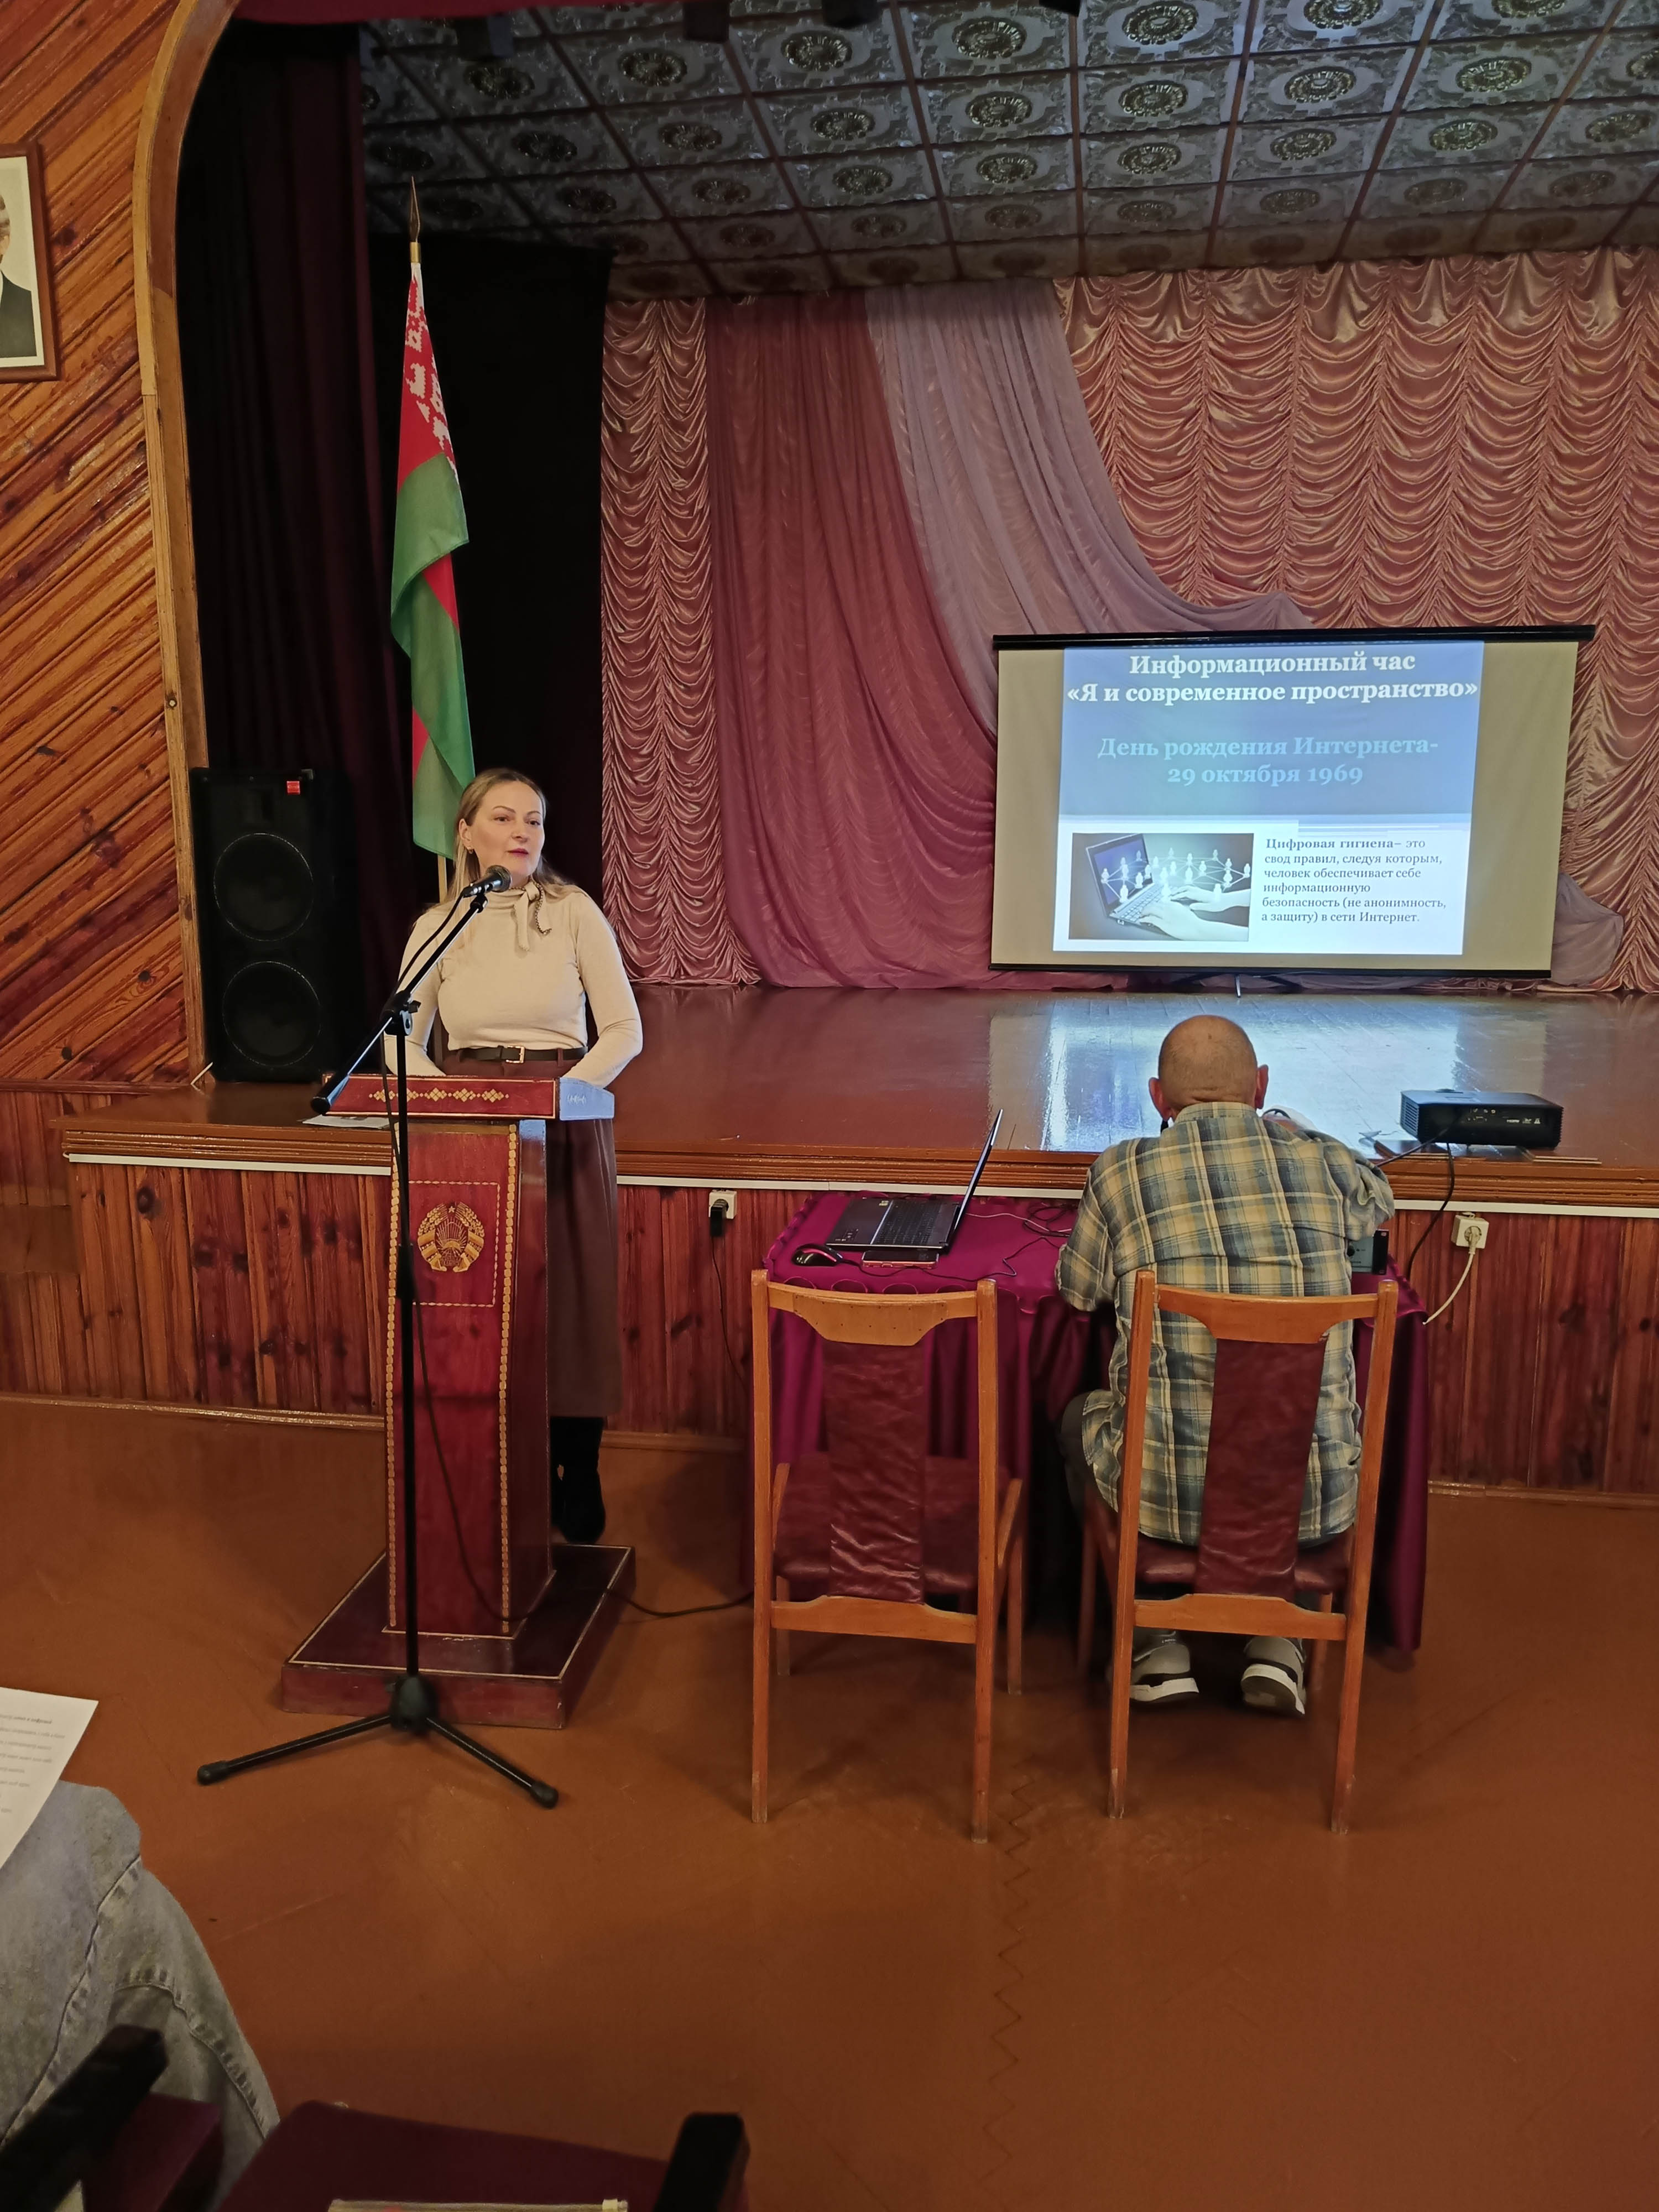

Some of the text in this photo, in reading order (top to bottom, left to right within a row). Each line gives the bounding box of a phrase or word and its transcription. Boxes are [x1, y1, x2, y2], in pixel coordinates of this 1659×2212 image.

[1129, 650, 1416, 678] Информационный час
[1067, 682, 1478, 706] «Я и современное пространство»
[1098, 738, 1159, 759] День
[1164, 739, 1287, 760] рождения
[1167, 764, 1364, 787] 29 октября 1969
[1266, 839, 1335, 850] Цифровая
[1265, 854, 1442, 865] свод правил, следуя которым,
[1264, 868, 1421, 878] человек обеспечивает себе
[1264, 883, 1370, 894] информационную
[1262, 897, 1446, 908] безопасность (не анонимность,
[1271, 911, 1318, 923] защиту)
[1359, 912, 1420, 924] Интернет.
